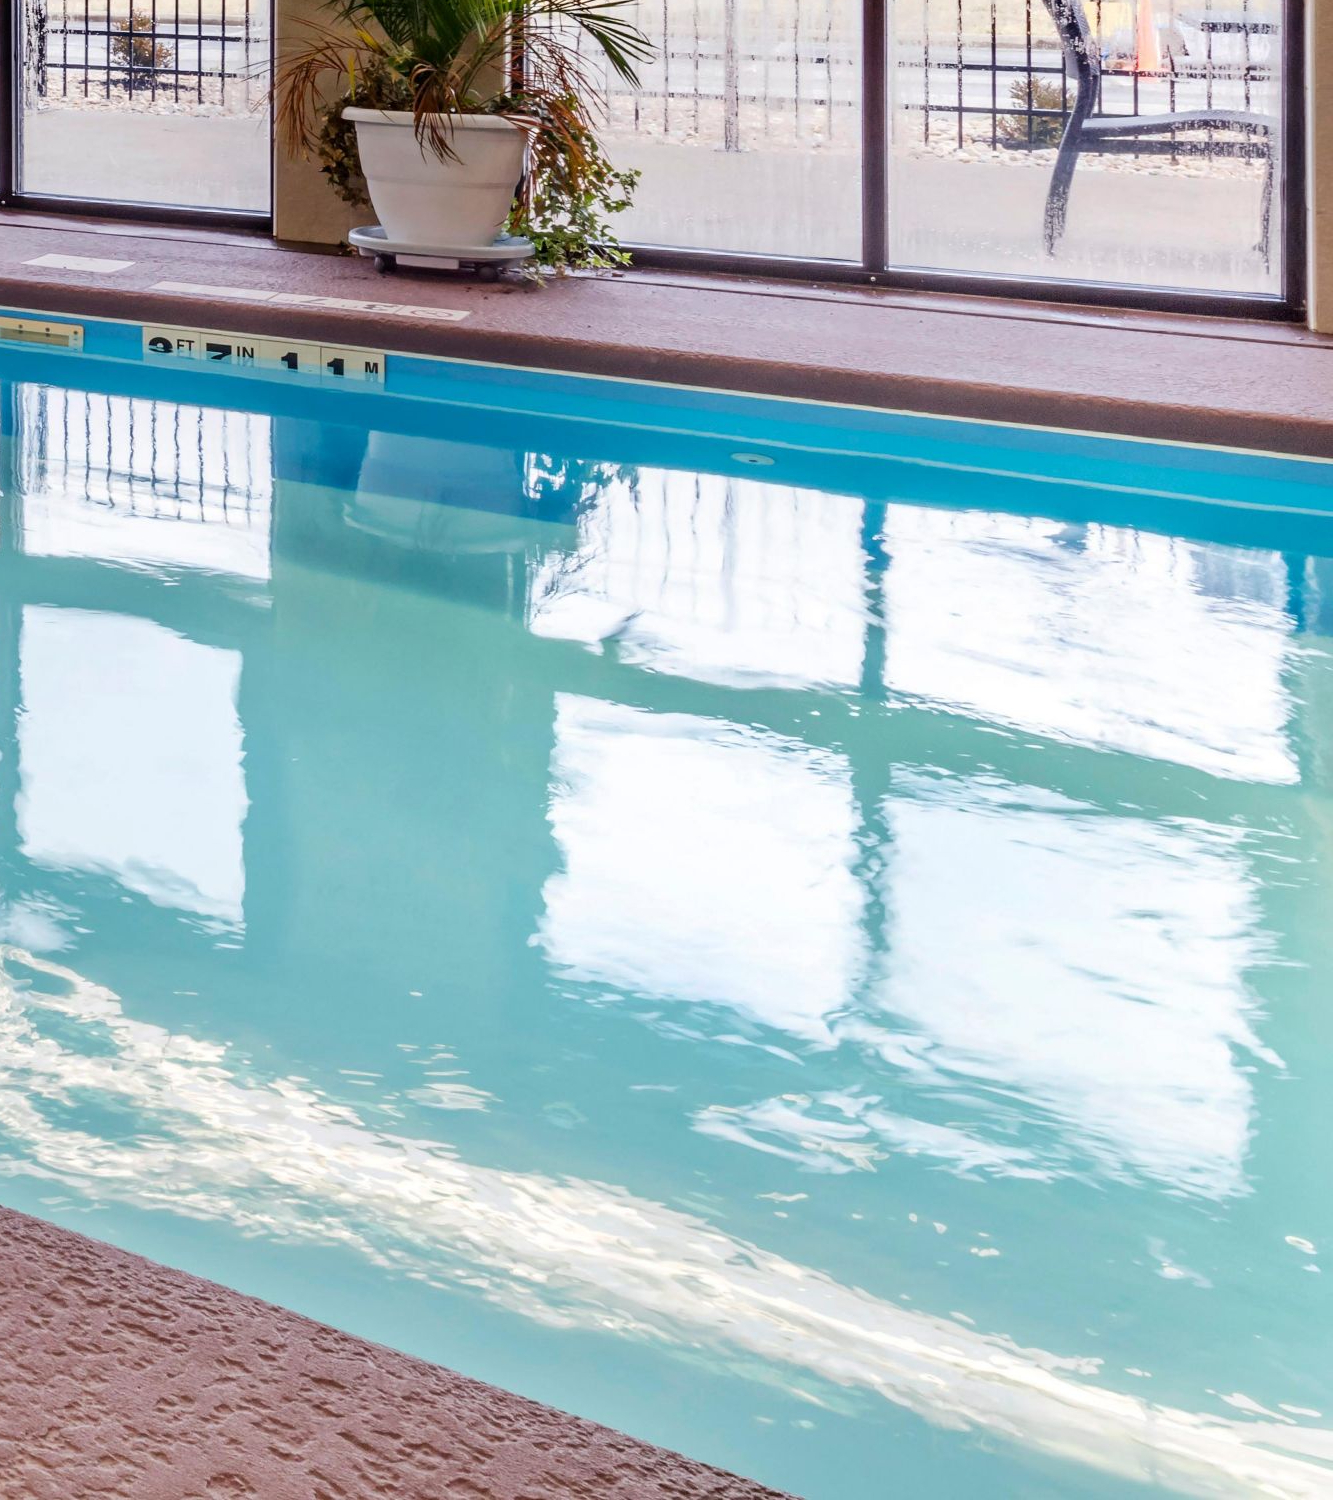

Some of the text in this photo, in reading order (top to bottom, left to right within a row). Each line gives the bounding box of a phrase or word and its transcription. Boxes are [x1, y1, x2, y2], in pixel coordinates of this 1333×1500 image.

[177, 339, 194, 351] FT
[237, 346, 254, 358] IN
[365, 362, 379, 374] M
